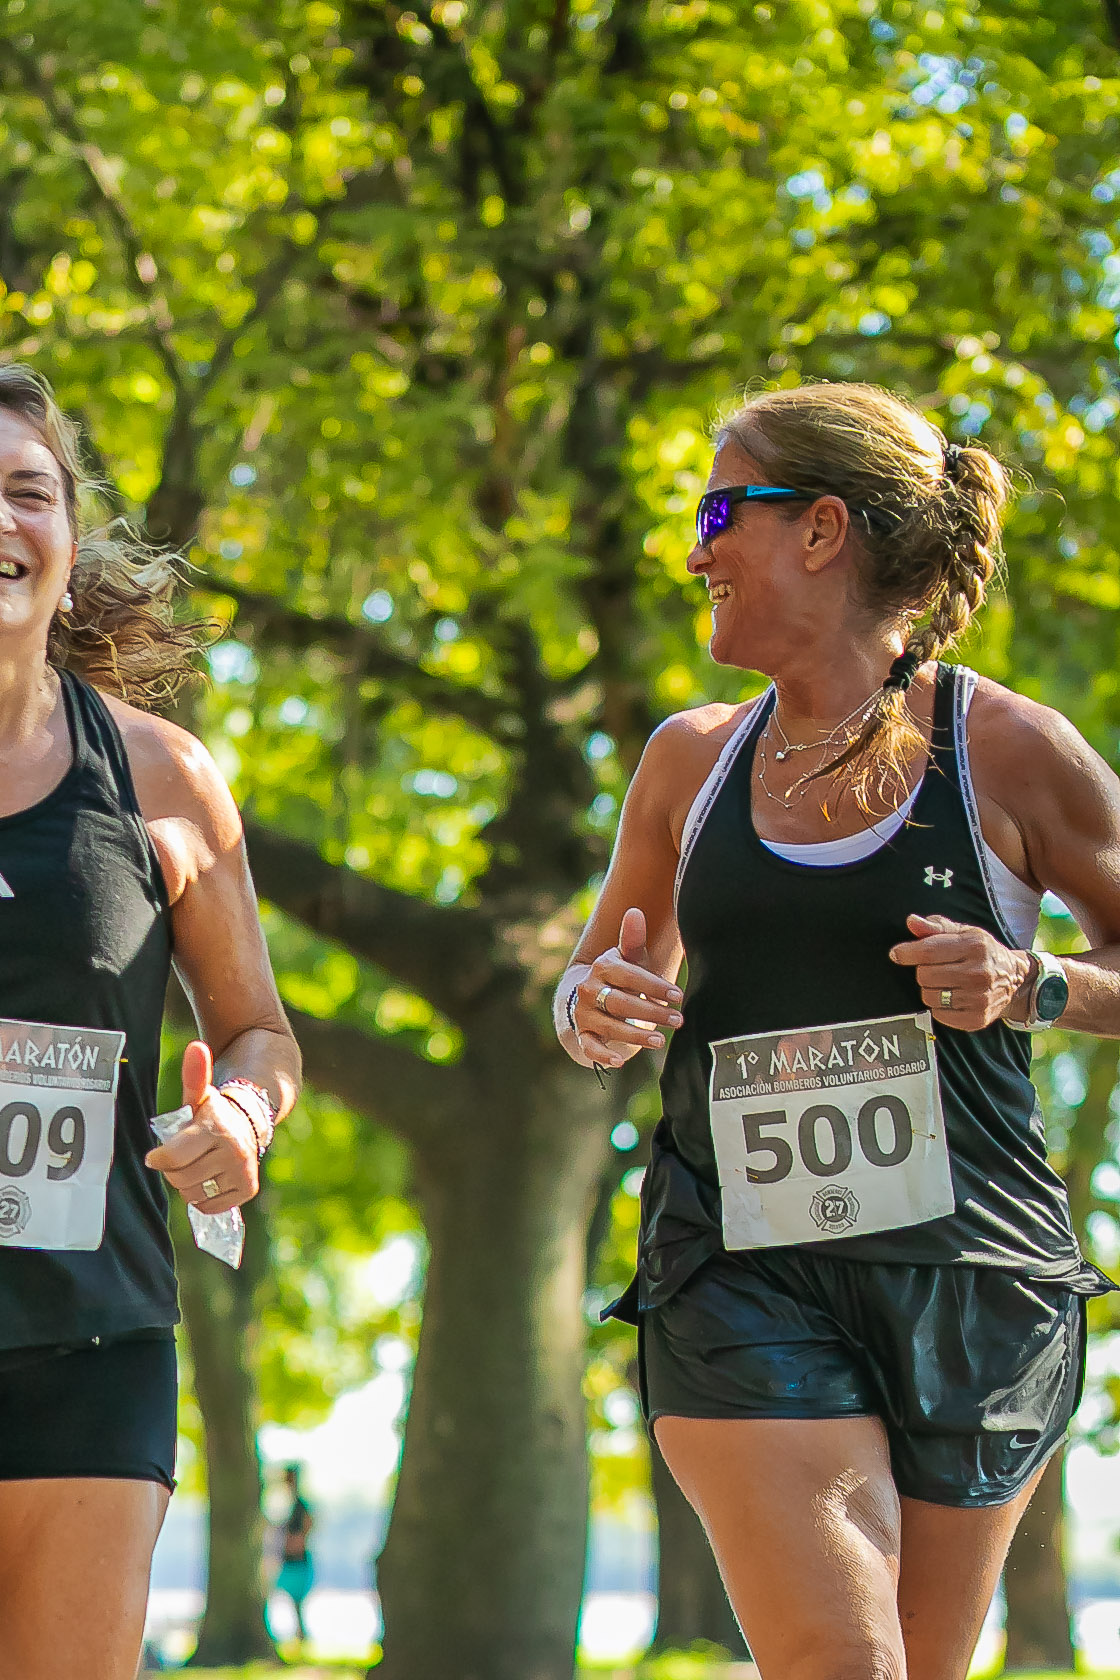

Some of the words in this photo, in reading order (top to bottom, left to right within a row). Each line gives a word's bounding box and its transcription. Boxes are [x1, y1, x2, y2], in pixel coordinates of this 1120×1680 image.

[768, 1029, 902, 1076] MARATÓN
[719, 1081, 773, 1100] ASOCIACIÓN
[773, 1078, 822, 1093] BOMBEROS
[822, 1069, 887, 1086] VOLUNTARIOS
[887, 1060, 927, 1077] ROSARIO
[741, 1094, 913, 1185] 500
[0, 1200, 19, 1218] 27
[824, 1199, 845, 1218] 27
